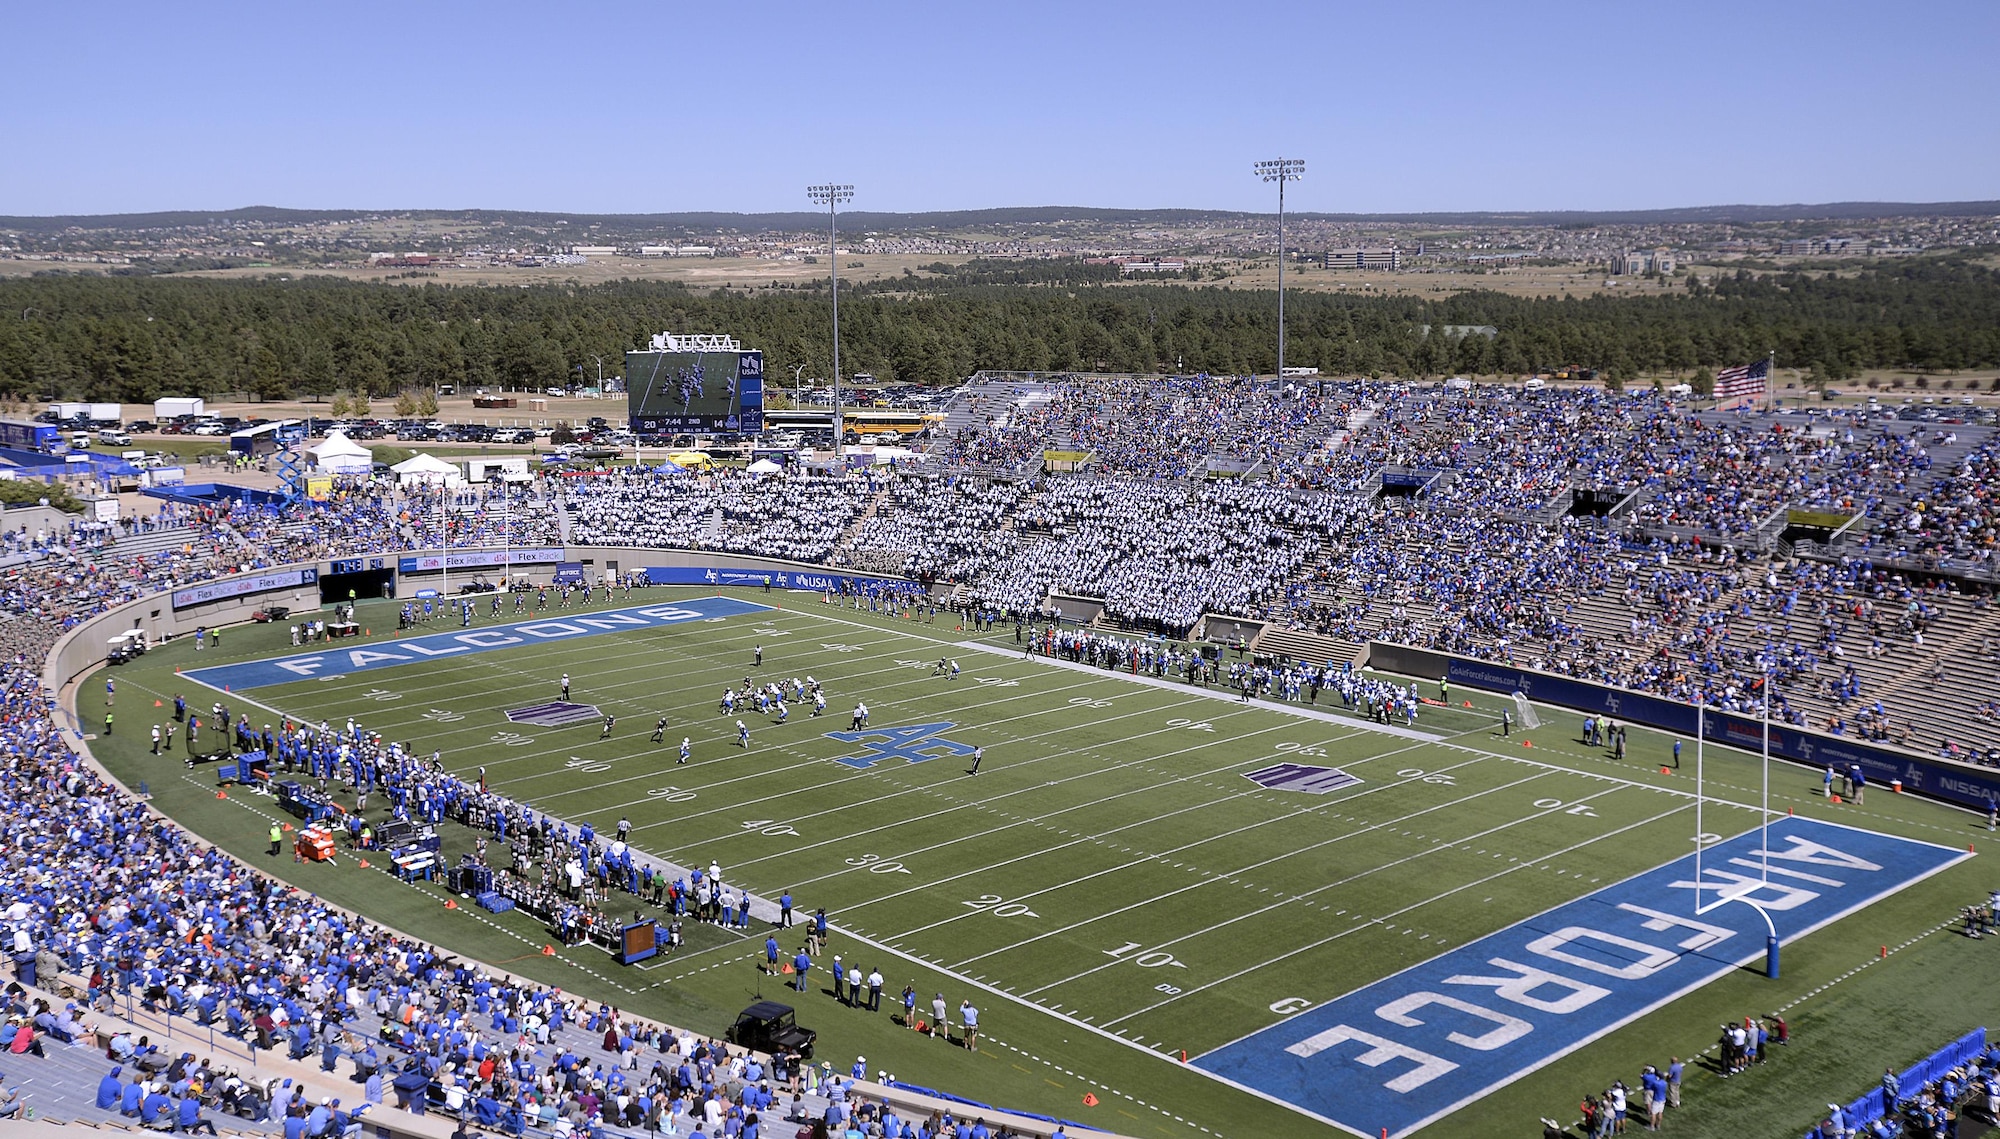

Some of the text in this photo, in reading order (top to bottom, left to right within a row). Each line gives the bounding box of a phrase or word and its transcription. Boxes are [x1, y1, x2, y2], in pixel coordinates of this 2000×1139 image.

[681, 334, 733, 351] USAA
[714, 420, 724, 428] 14
[1593, 491, 1617, 504] IMG
[446, 557, 464, 565] Flex
[518, 553, 536, 561] Flex
[539, 551, 560, 560] Pack
[259, 579, 275, 587] Flex
[808, 576, 833, 589] USAA
[275, 607, 703, 675] FALCONS
[1450, 665, 1516, 686] GoAirForceFalcons.com
[564, 755, 612, 773] 40
[647, 786, 697, 803] 50
[1533, 797, 1592, 816] 10
[740, 819, 794, 836] 40
[845, 853, 903, 874] 30
[961, 894, 1030, 917] 20
[1102, 941, 1174, 968] 10
[1284, 835, 1884, 1094] AIR FORCE
[1269, 997, 1312, 1015] G
